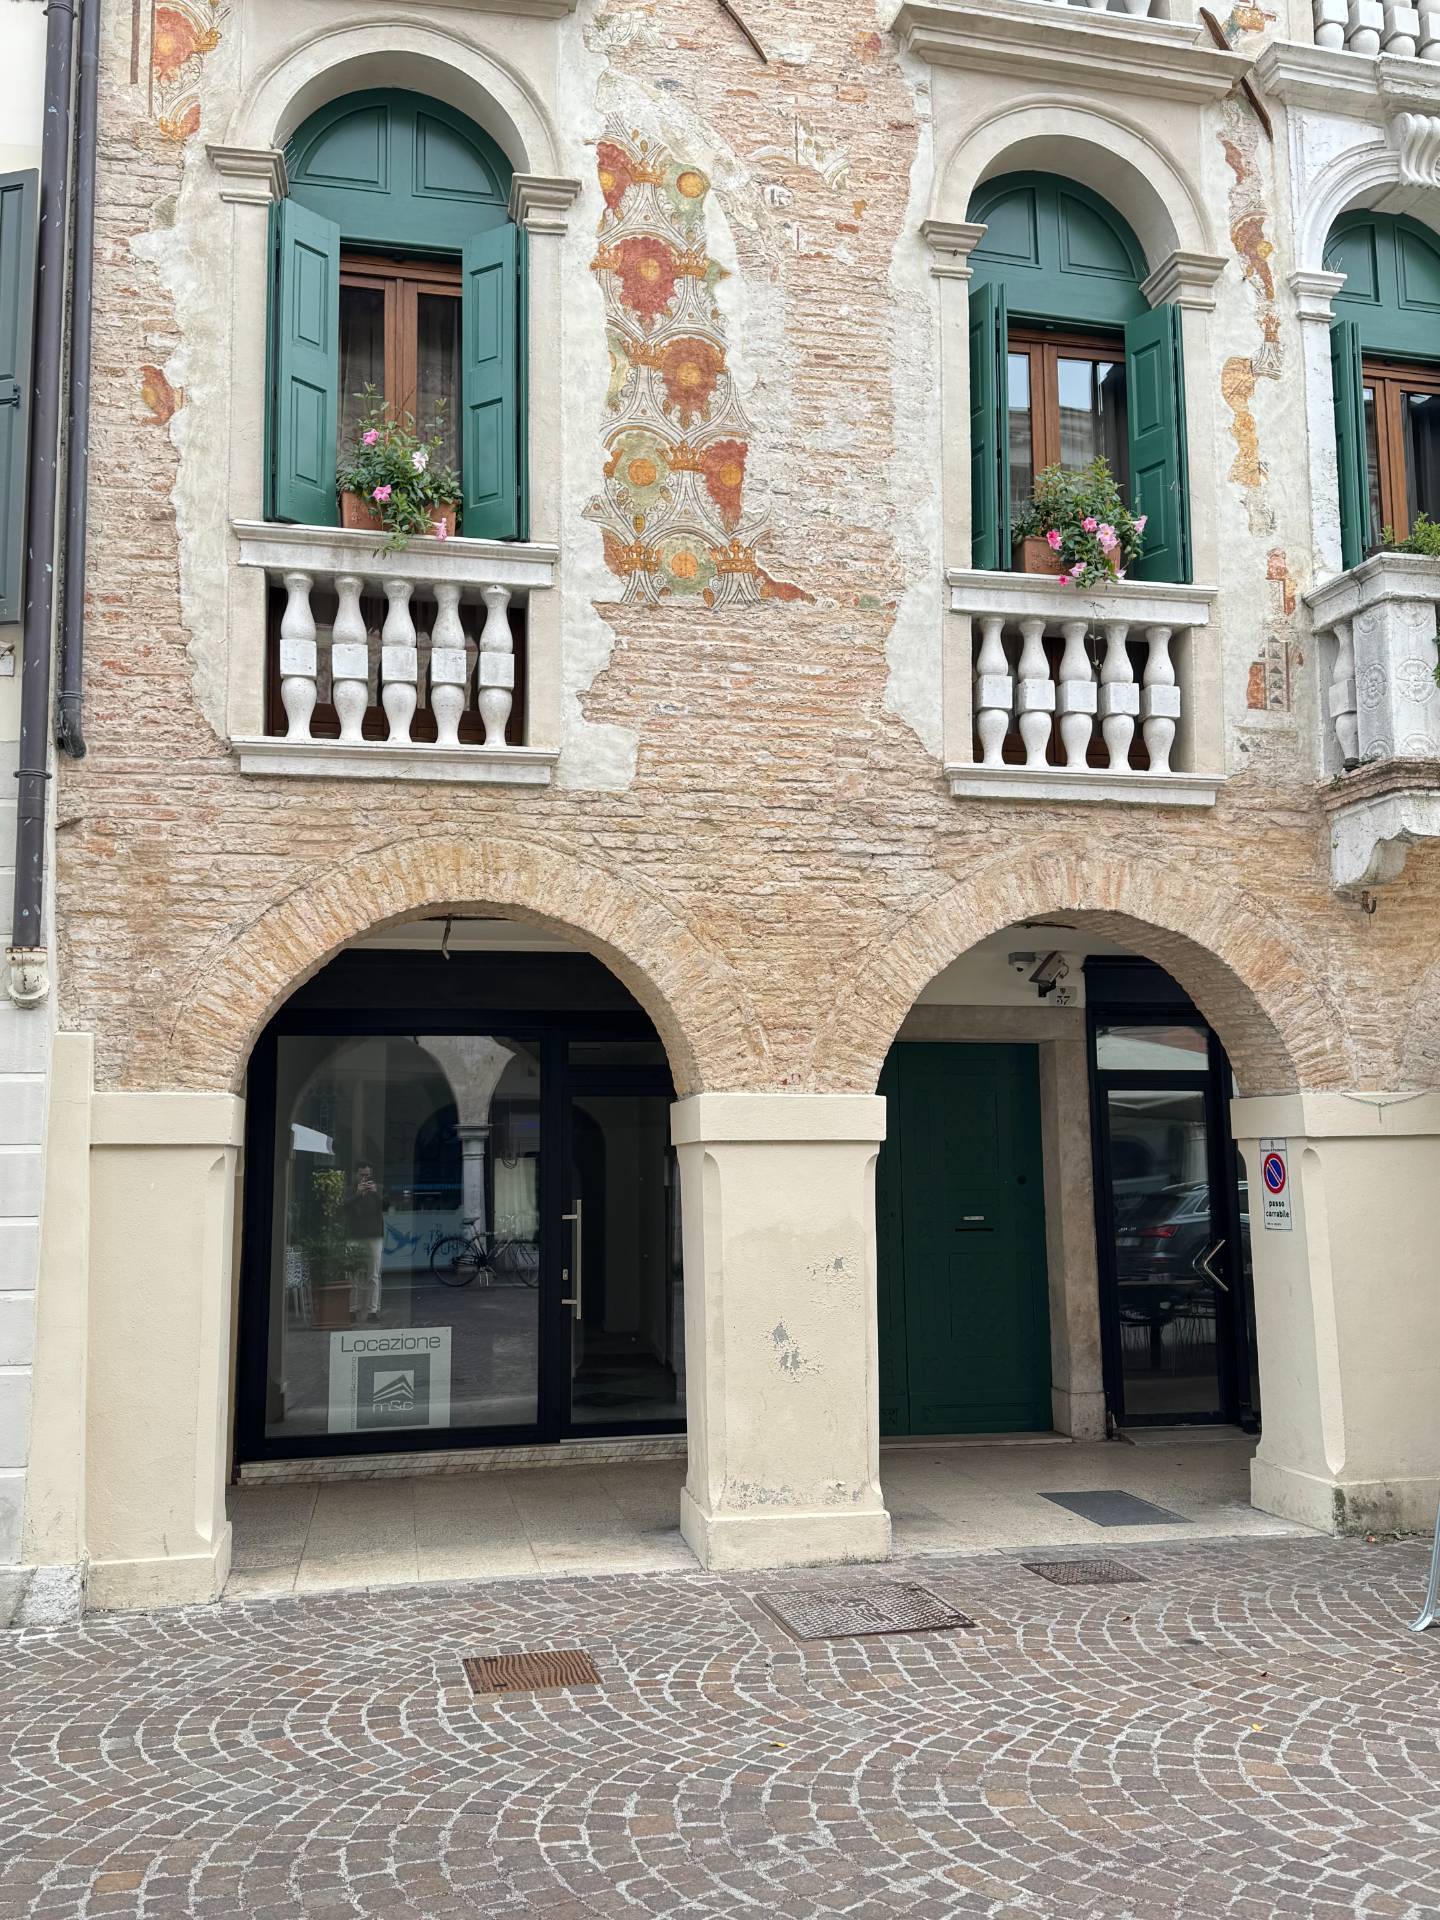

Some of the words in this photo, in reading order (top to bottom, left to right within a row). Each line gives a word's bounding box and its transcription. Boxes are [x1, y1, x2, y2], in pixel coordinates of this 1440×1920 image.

[1268, 1200, 1285, 1208] passo
[1265, 1210, 1290, 1218] carrabile
[341, 1333, 441, 1353] Locazione
